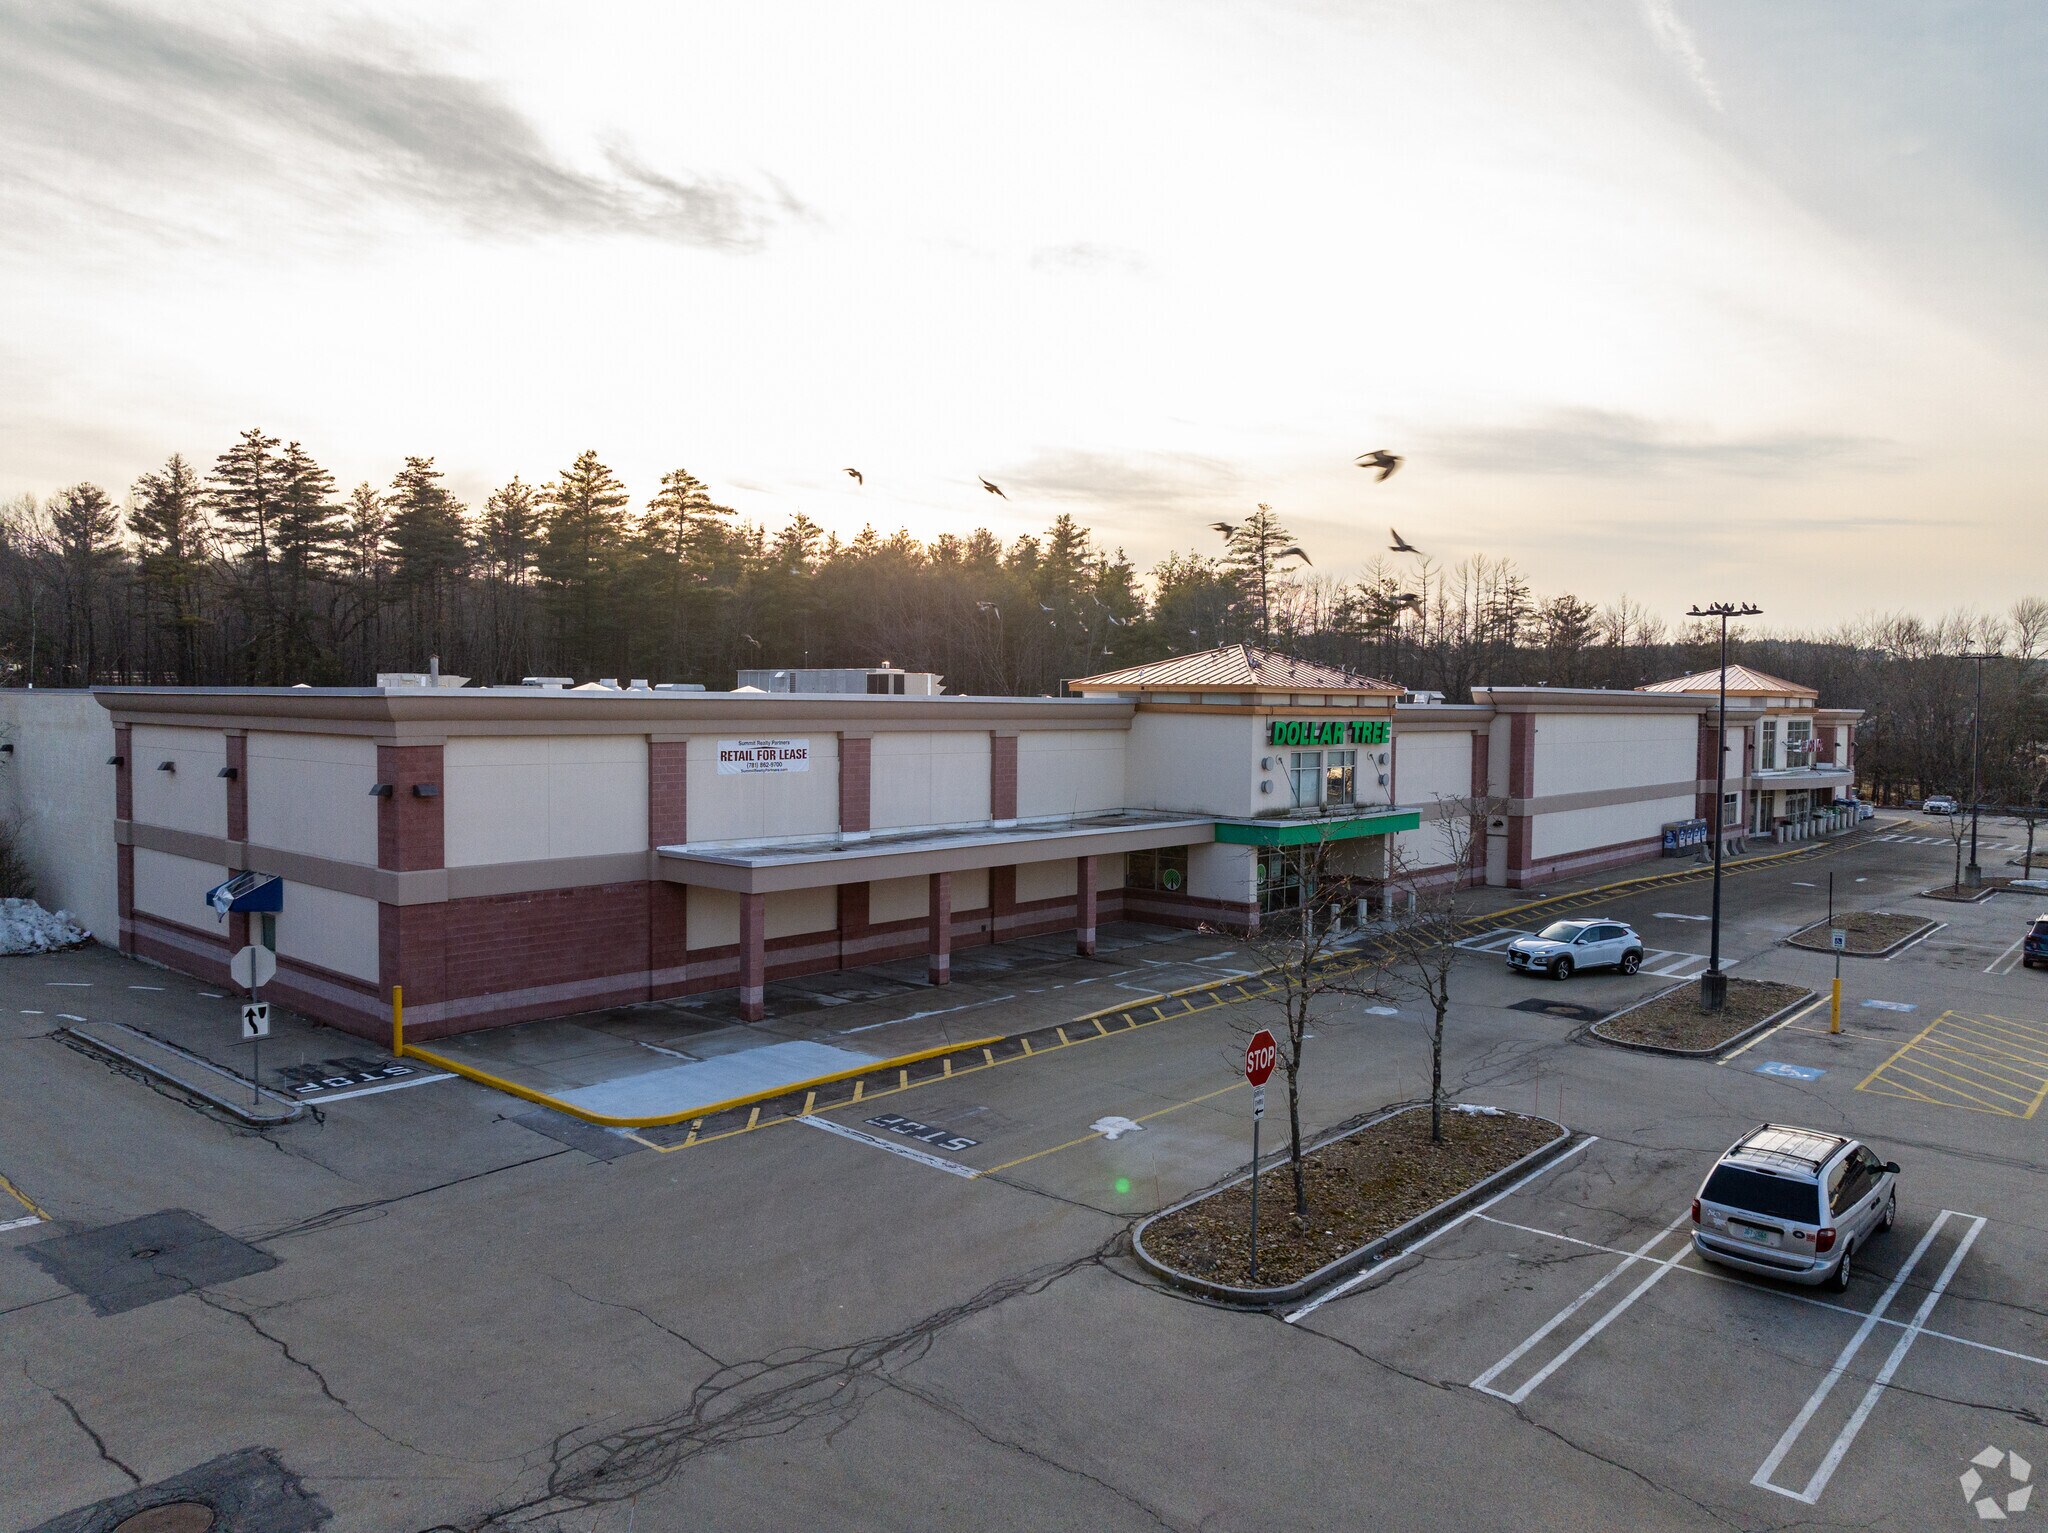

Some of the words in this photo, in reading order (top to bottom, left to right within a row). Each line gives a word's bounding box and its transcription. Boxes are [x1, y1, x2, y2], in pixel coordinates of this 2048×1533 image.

[1272, 721, 1345, 746] DOLLAR
[1351, 721, 1392, 744] TREE
[720, 750, 754, 762] RETAIL
[757, 749, 776, 761] FOR
[779, 748, 807, 760] LEASE
[1247, 1045, 1275, 1073] STOP
[295, 1066, 415, 1093] STOP
[865, 1117, 978, 1151] STOP
